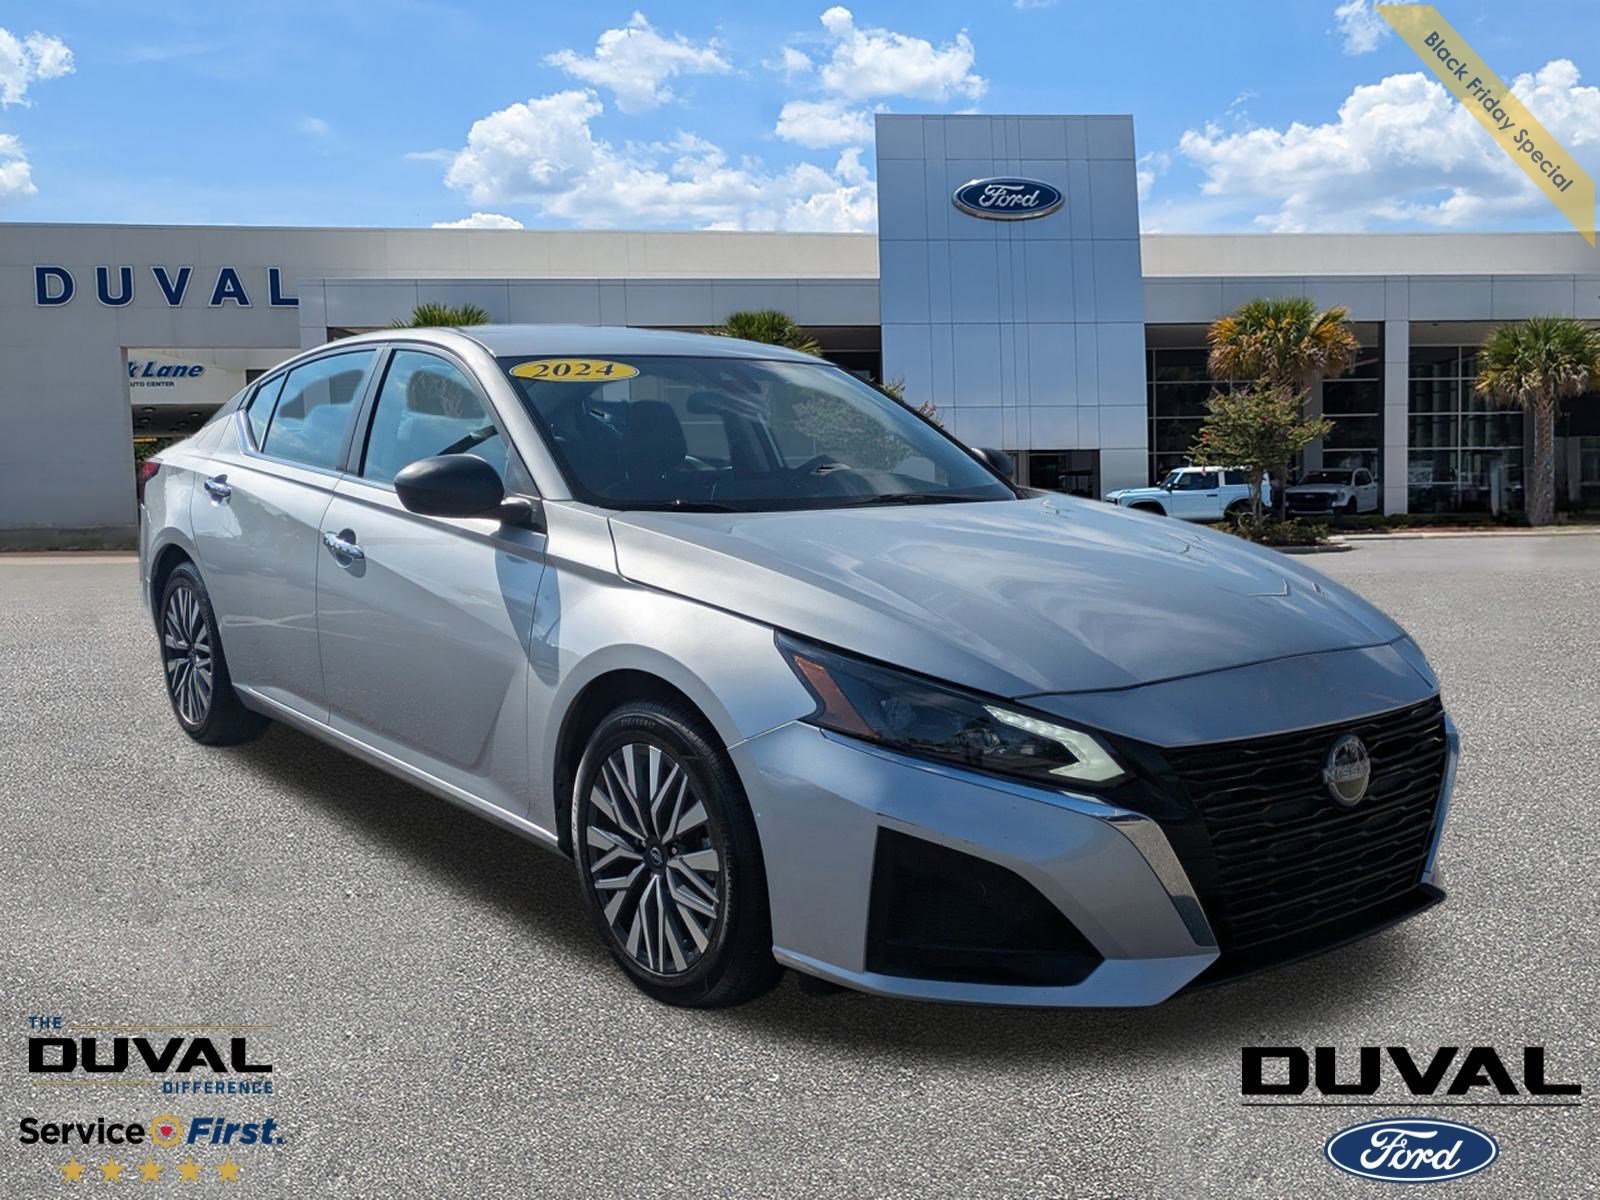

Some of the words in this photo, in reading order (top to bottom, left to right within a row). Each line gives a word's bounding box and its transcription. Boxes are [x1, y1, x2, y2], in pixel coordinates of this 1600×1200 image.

[978, 184, 1040, 207] Ford
[33, 265, 299, 307] DUVAL
[141, 361, 205, 378] Lane
[531, 362, 615, 378] 2024
